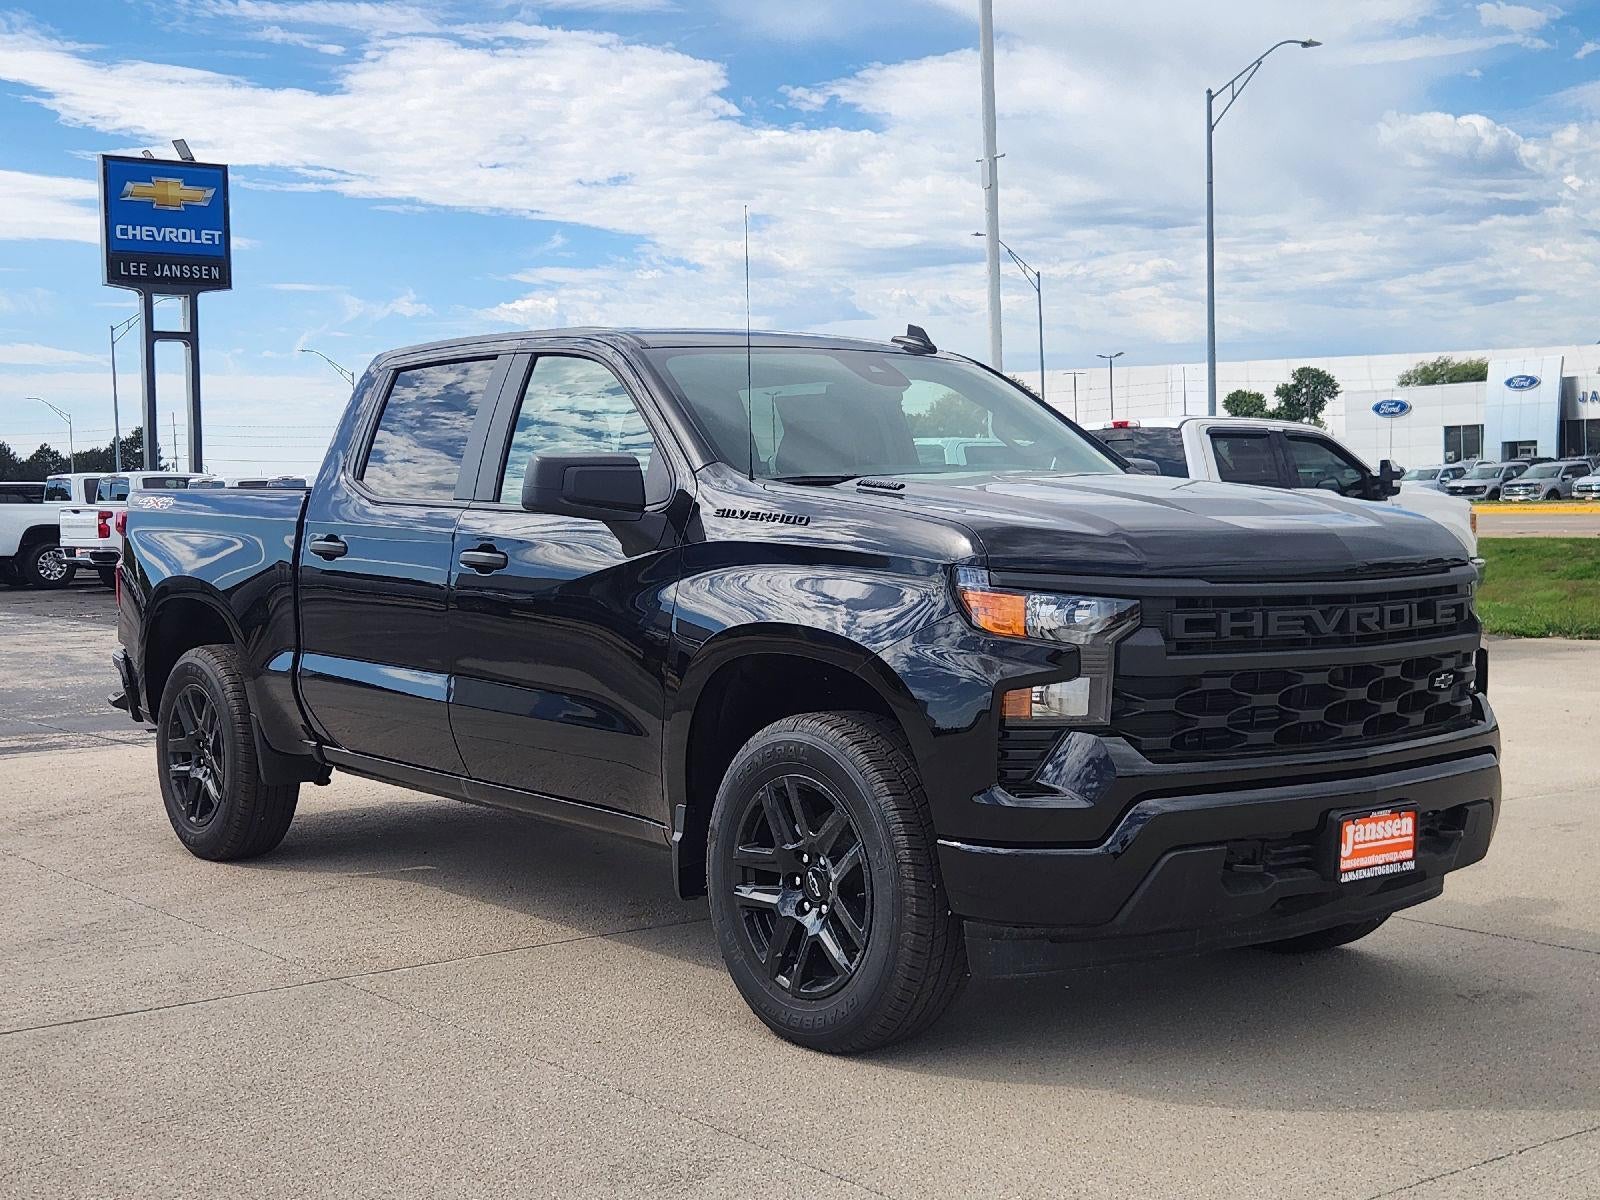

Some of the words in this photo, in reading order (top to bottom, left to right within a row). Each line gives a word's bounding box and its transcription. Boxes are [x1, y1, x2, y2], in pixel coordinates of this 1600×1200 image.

[115, 224, 222, 245] CHEVROLET
[119, 261, 148, 277] LEE
[153, 263, 220, 280] JANSSEN
[713, 508, 811, 526] SILVERADO
[1171, 599, 1468, 638] CHEVROLET
[1340, 816, 1413, 858] Janssen
